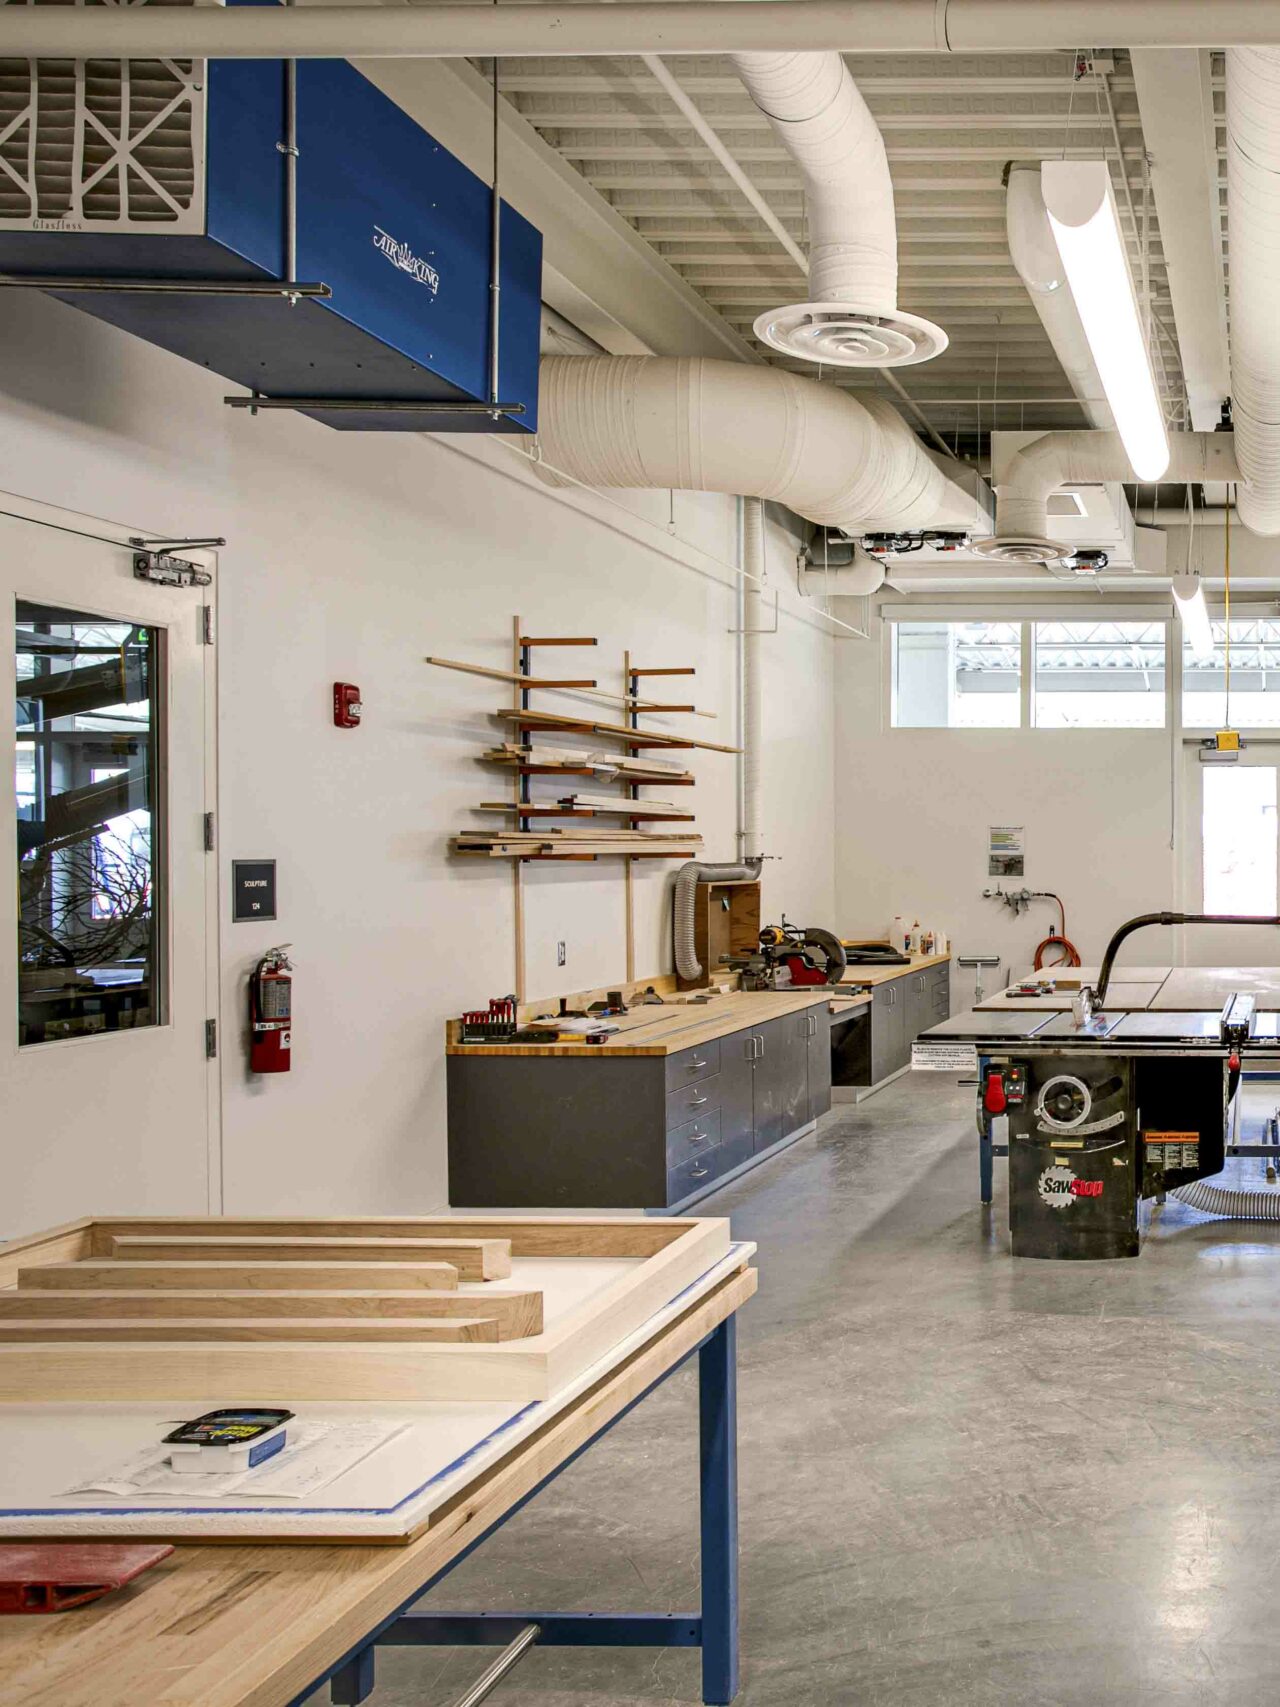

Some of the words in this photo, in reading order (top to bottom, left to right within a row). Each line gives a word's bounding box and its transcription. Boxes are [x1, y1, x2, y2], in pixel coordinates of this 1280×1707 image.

[373, 236, 400, 269] AIR
[410, 257, 440, 295] KING
[244, 880, 268, 888] SCULPTURE
[1043, 1177, 1104, 1197] SawStop
